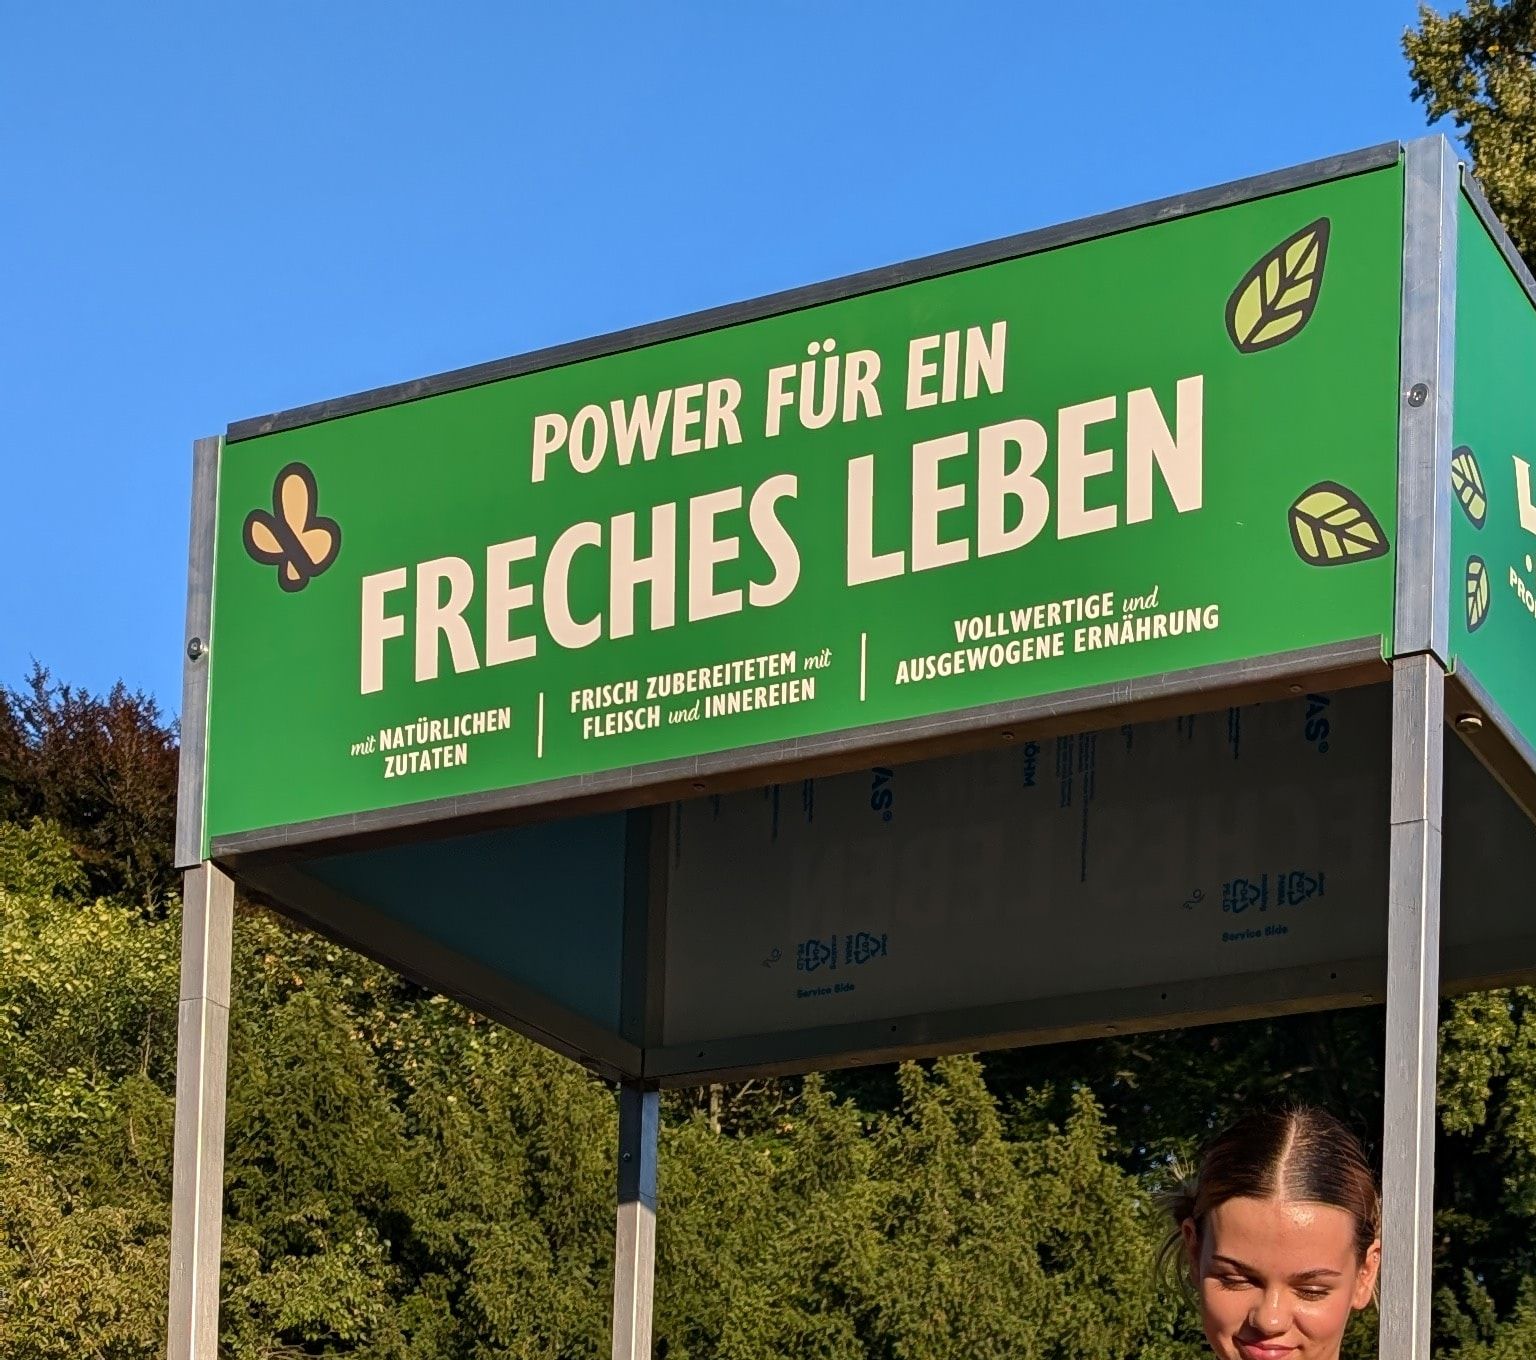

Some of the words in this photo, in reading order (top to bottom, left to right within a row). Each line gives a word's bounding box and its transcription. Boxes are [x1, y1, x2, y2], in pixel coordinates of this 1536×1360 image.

[531, 378, 742, 483] POWER
[765, 338, 882, 438] FÜR
[906, 321, 1007, 410] EIN
[360, 473, 801, 695] FRECHES
[846, 375, 1204, 587] LEBEN
[895, 634, 1064, 686] AUSGEWOGENE
[1074, 604, 1219, 654] ERNÄHRUNG
[954, 591, 1114, 643] VOLLWERTIGE
[1122, 585, 1158, 612] und
[571, 679, 637, 714] FRISCH
[646, 650, 796, 702] ZUBEREITETEM
[803, 647, 832, 671] mit
[583, 704, 660, 740] FLEISCH
[668, 700, 700, 724] und
[705, 677, 815, 719] INNEREIEN
[351, 735, 376, 756] mit
[379, 707, 511, 751] NATÜRLICHEN
[383, 742, 467, 779] ZUTATEN
